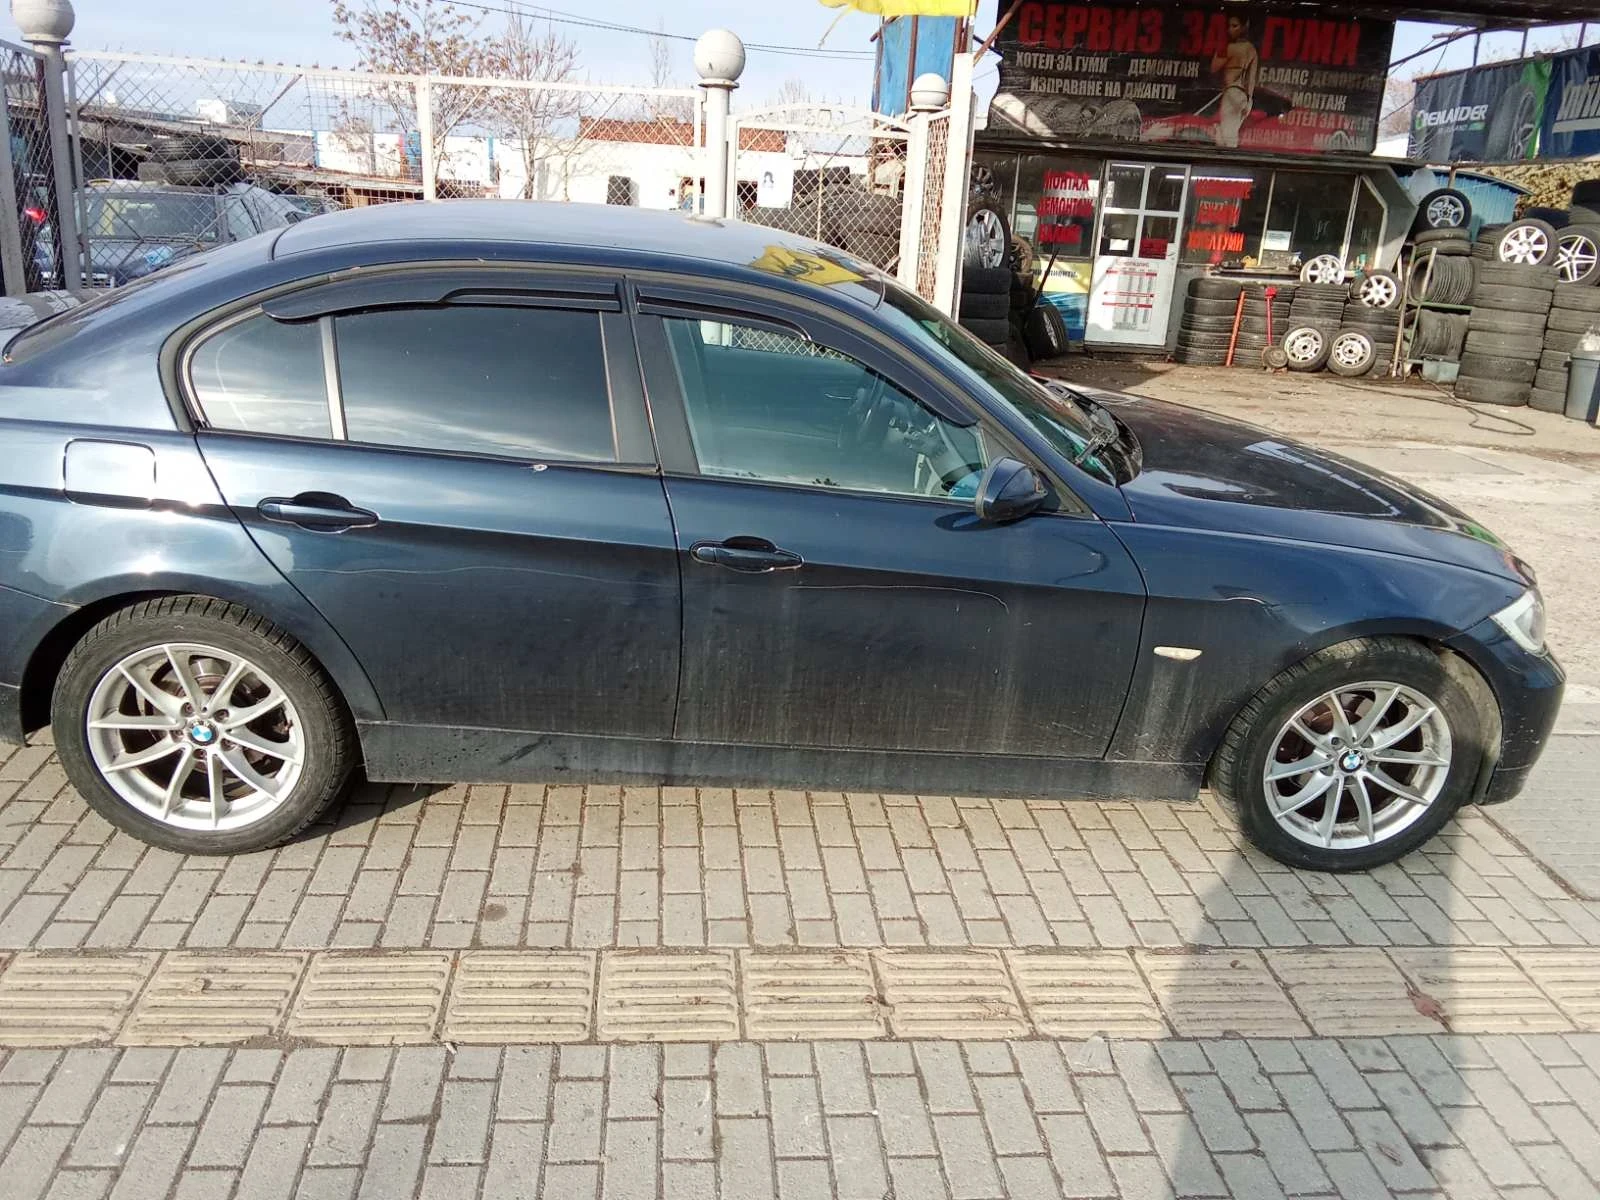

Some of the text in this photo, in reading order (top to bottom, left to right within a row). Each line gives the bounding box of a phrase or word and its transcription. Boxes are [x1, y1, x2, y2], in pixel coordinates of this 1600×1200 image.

[1018, 3, 1361, 65] СЕРВИЗ ЗА ГУМИ
[1016, 51, 1108, 73] ХОТЕЛ ЗА ГУМИ
[1128, 59, 1200, 77] ДЕМОНТАЖ
[1260, 67, 1309, 85] БАЛАНС
[1030, 76, 1177, 100] ИЗПРАВЯНЕ НА ДЖАНТИ
[1292, 91, 1347, 111] МОНТАЖ
[1279, 110, 1317, 127] ОТЕЛ
